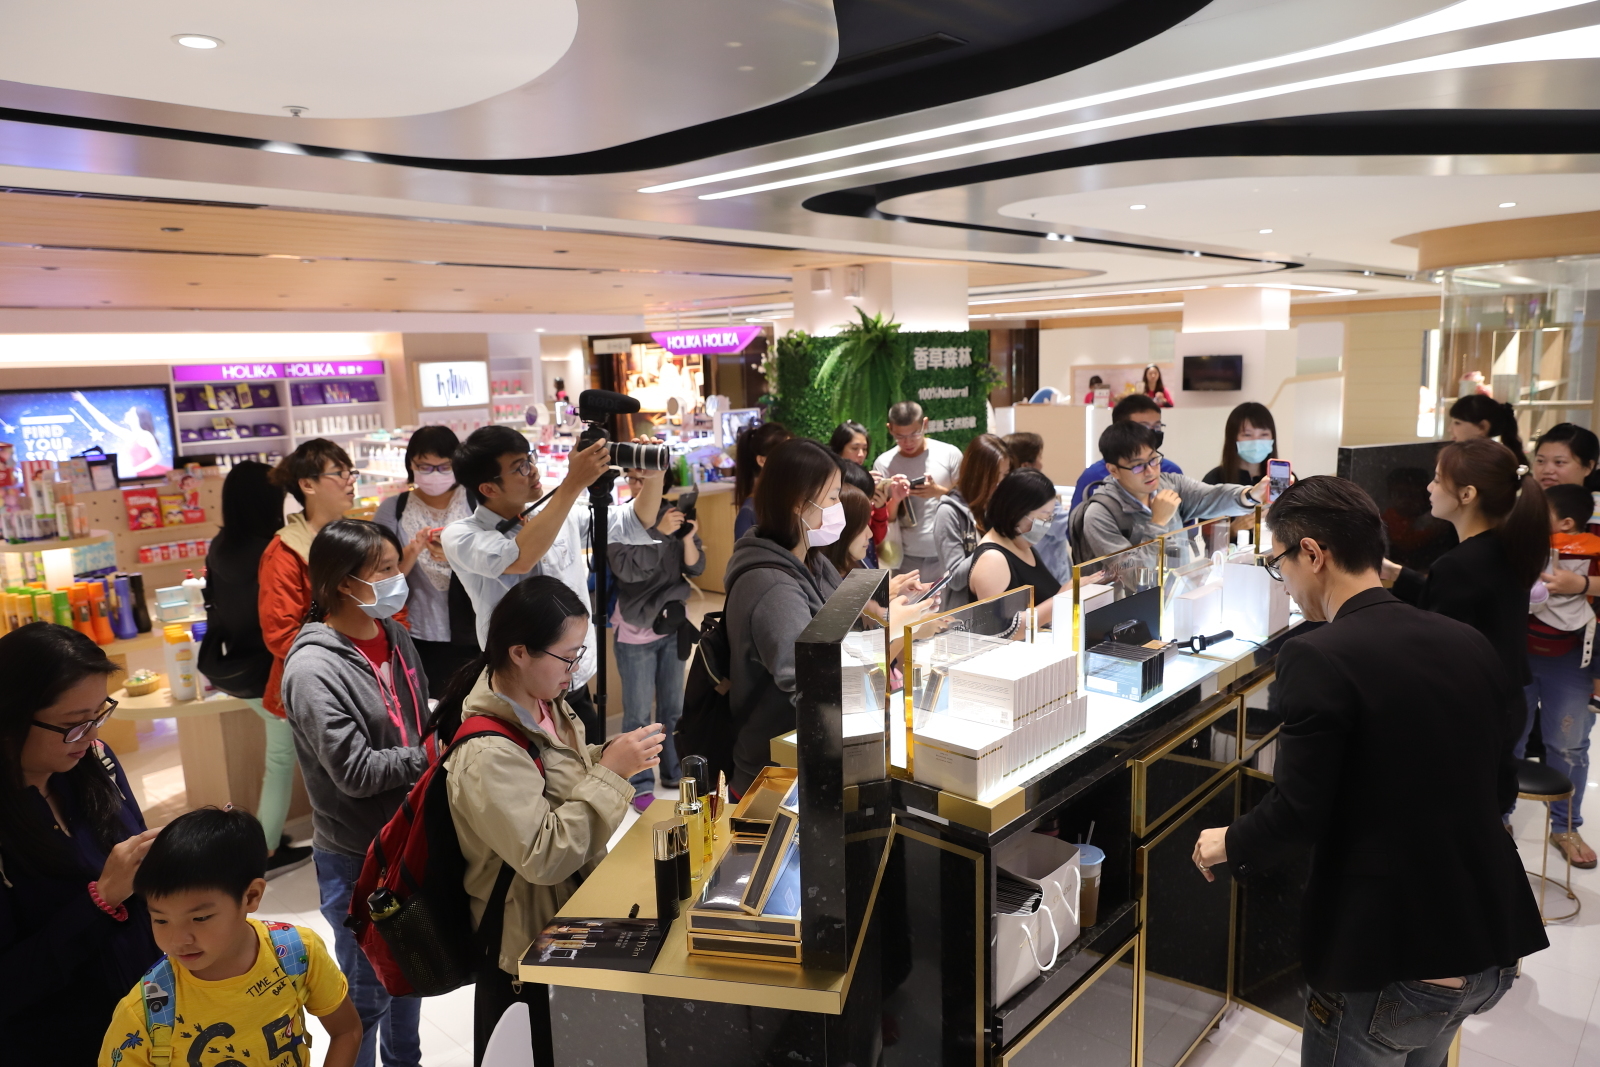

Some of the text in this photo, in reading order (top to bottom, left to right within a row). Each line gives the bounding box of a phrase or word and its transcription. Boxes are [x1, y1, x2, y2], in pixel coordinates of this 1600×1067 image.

[666, 332, 739, 349] HOLIKA HOLIKA
[913, 345, 973, 370] 香草森林
[221, 364, 277, 379] HOLIKA
[285, 362, 335, 377] HOLIKA
[22, 424, 64, 439] FIND
[24, 436, 73, 451] YOUR
[245, 966, 280, 997] TIME T
